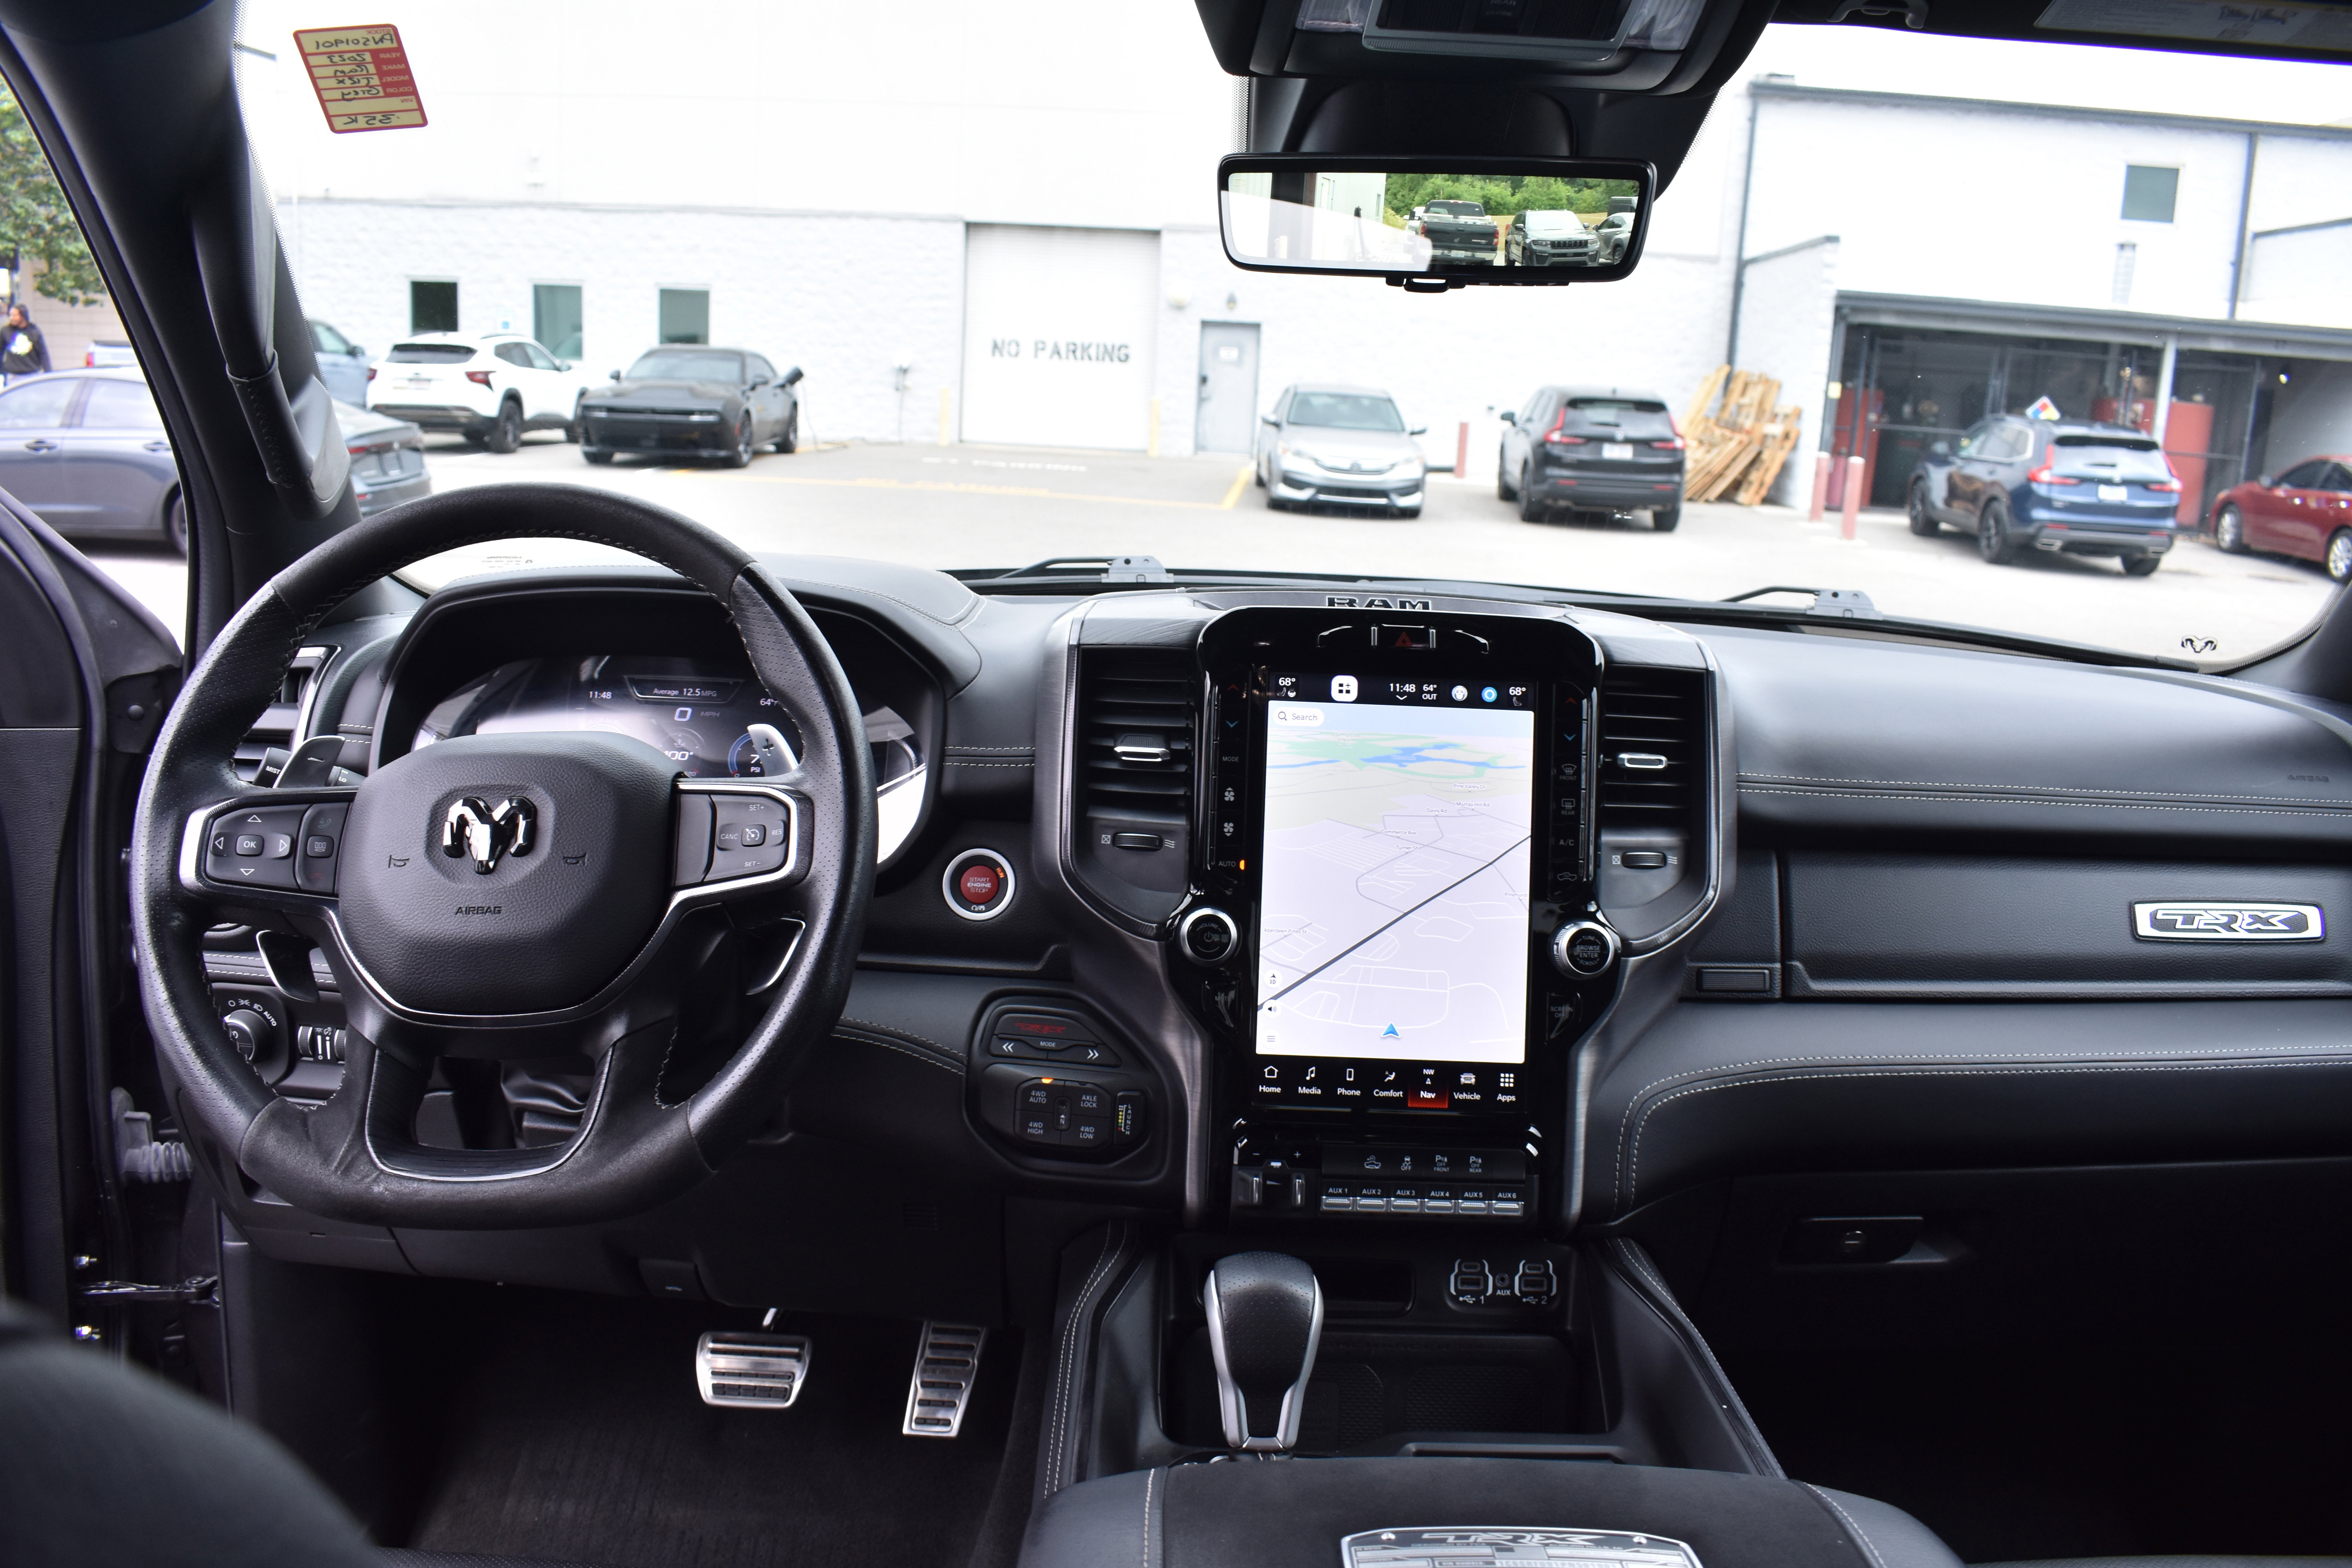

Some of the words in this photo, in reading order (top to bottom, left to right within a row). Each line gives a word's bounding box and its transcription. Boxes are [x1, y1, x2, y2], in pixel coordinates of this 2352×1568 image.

[992, 339, 1020, 357] NO
[1034, 340, 1130, 363] PARKING
[1327, 597, 1432, 610] RAM
[1278, 677, 1296, 686] 68°
[1390, 683, 1416, 693] 11:48
[1509, 686, 1526, 695] 68°
[674, 707, 693, 722] 0
[265, 766, 281, 775] MIST
[454, 905, 502, 915] AIRBAG
[2156, 909, 2299, 934] TRX
[263, 1011, 277, 1027] AUTO
[1259, 1085, 1281, 1093] Home
[1337, 1088, 1361, 1096] Phone
[1373, 1089, 1403, 1098] Comfort
[1454, 1092, 1481, 1100] Vehicle
[1480, 1295, 1484, 1304] 1
[1541, 1296, 1547, 1304] 2
[1423, 1532, 1606, 1545] TRX
